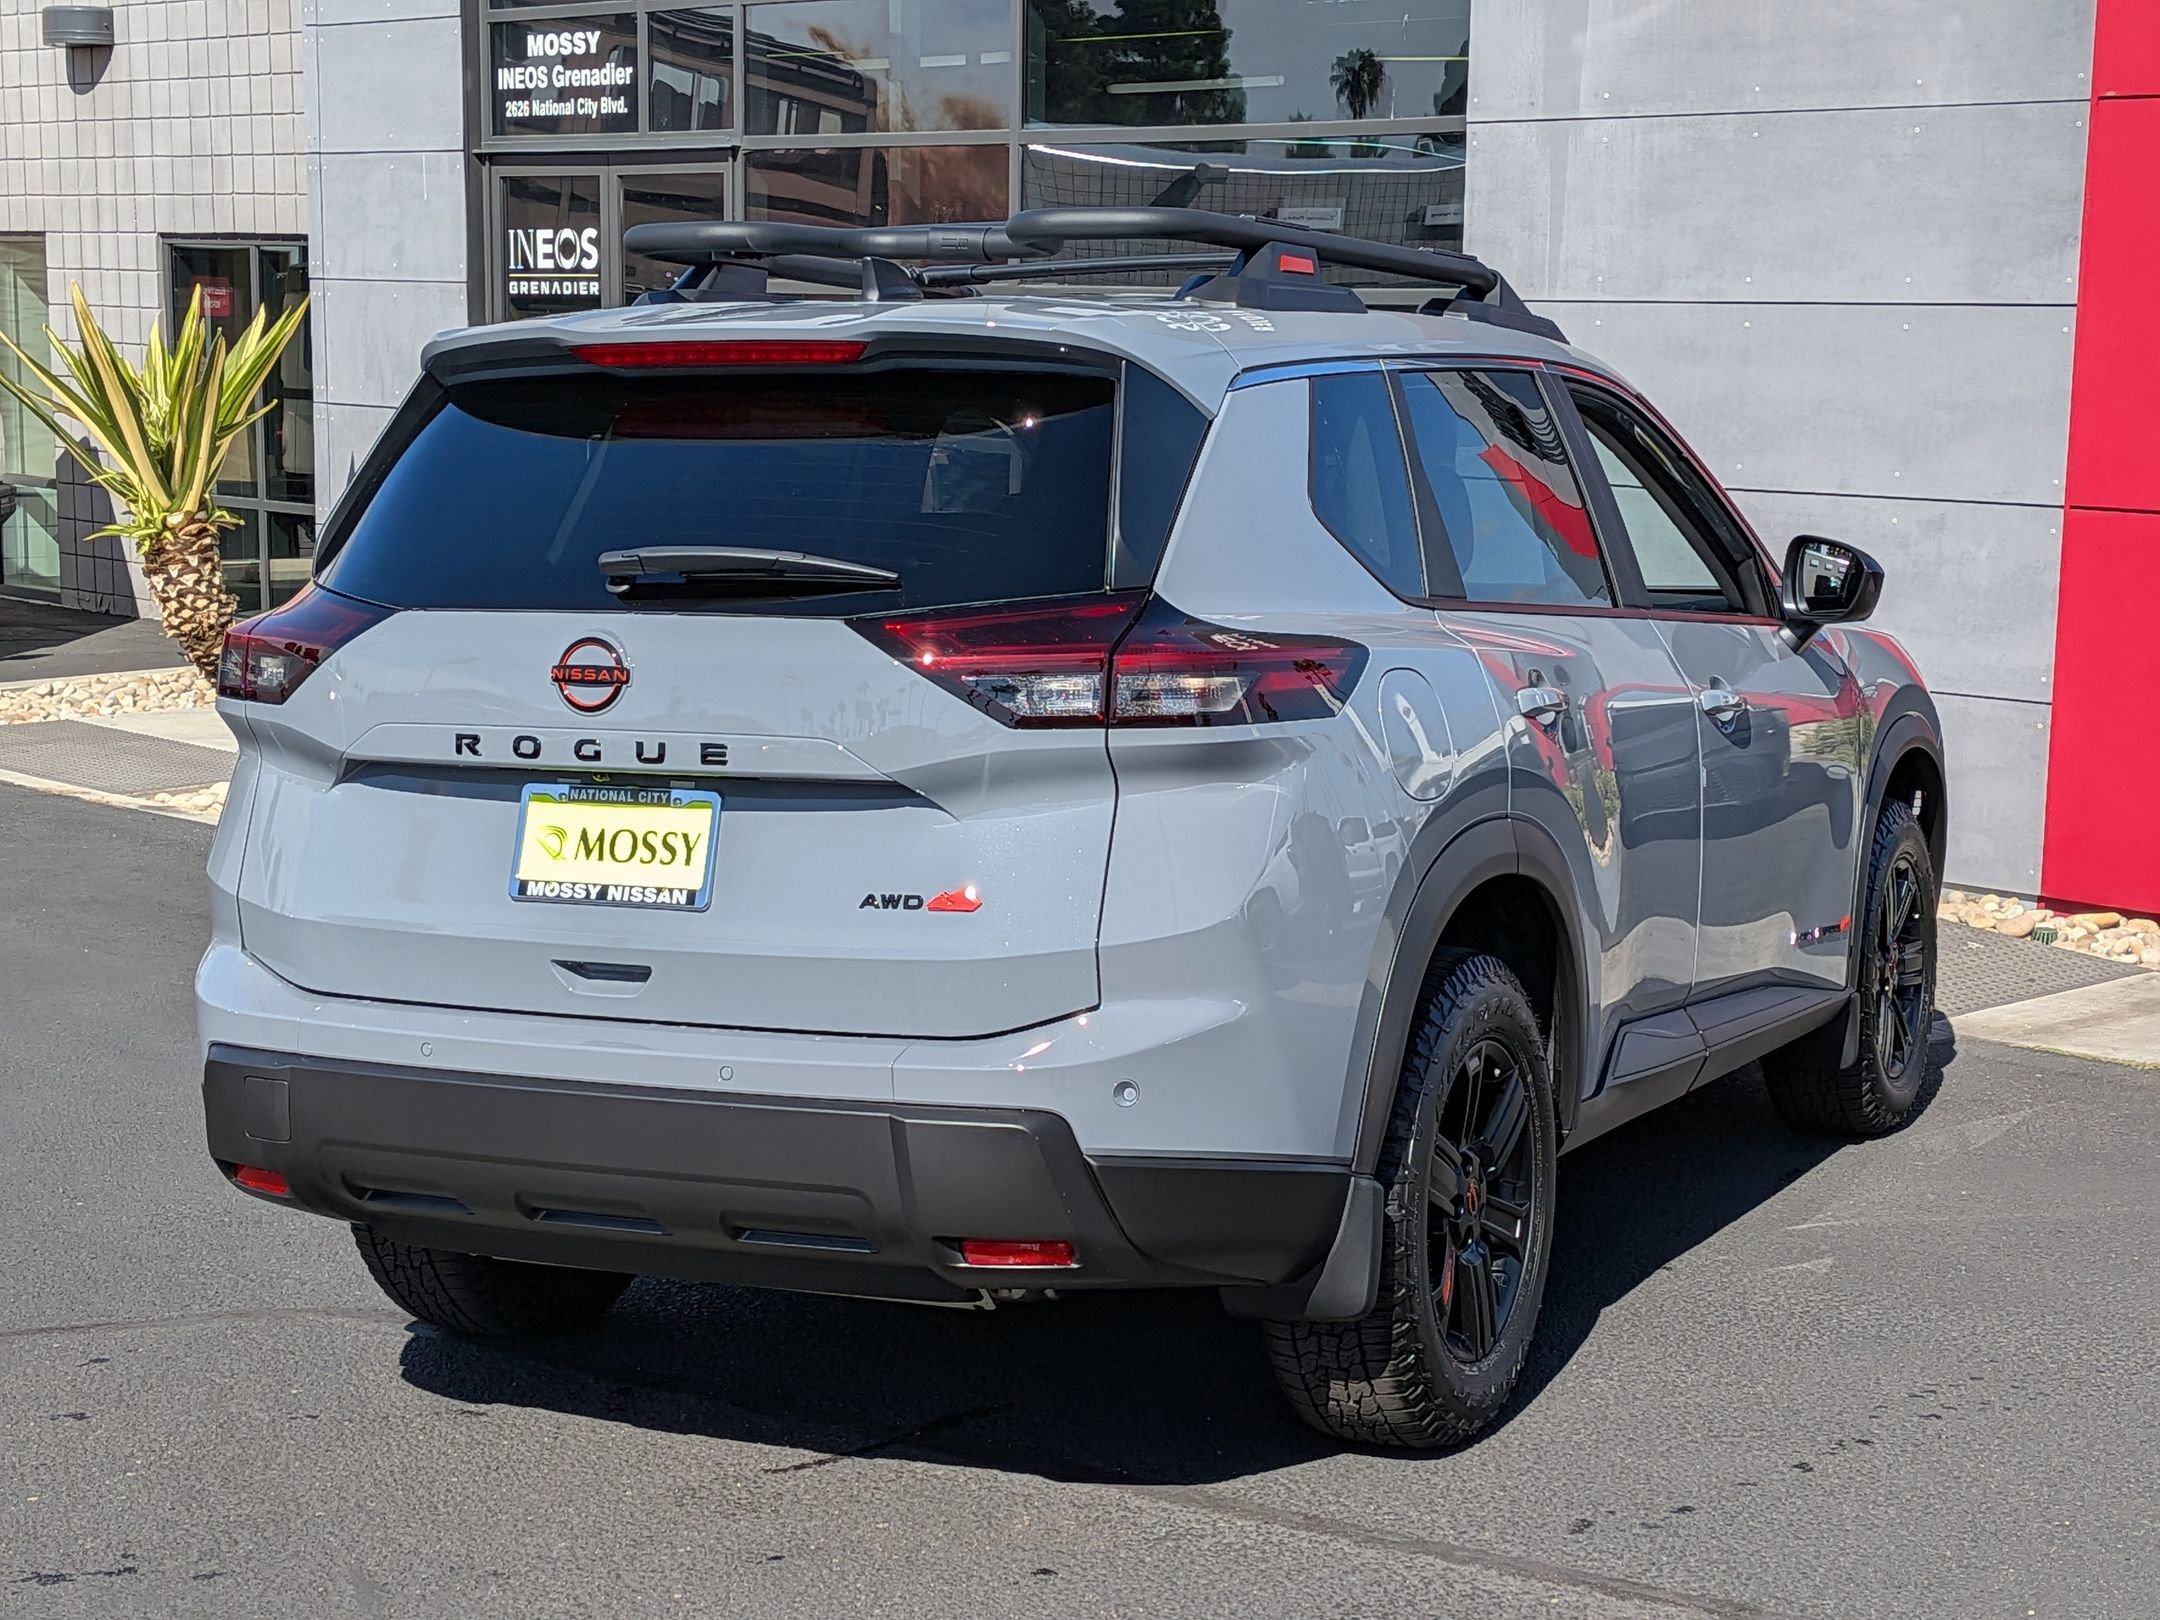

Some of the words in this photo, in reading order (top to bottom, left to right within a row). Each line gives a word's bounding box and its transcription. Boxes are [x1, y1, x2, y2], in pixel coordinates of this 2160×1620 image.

[527, 31, 601, 57] MOSSY
[498, 66, 548, 90] INEOS
[552, 62, 633, 88] Grenadier
[506, 100, 529, 117] 2626
[532, 98, 574, 116] National
[577, 97, 598, 118] City
[601, 96, 628, 114] Blvd.
[508, 227, 599, 270] INEOS
[509, 281, 600, 296] GRENADIER
[552, 667, 629, 682] NISSAN
[455, 733, 729, 766] ROGUE
[570, 787, 634, 803] NATIONAL
[639, 790, 670, 804] CITY
[574, 827, 702, 867] MOSSY
[526, 880, 601, 901] MOSSY
[607, 885, 688, 905] NISSAN
[859, 893, 925, 910] AWD
